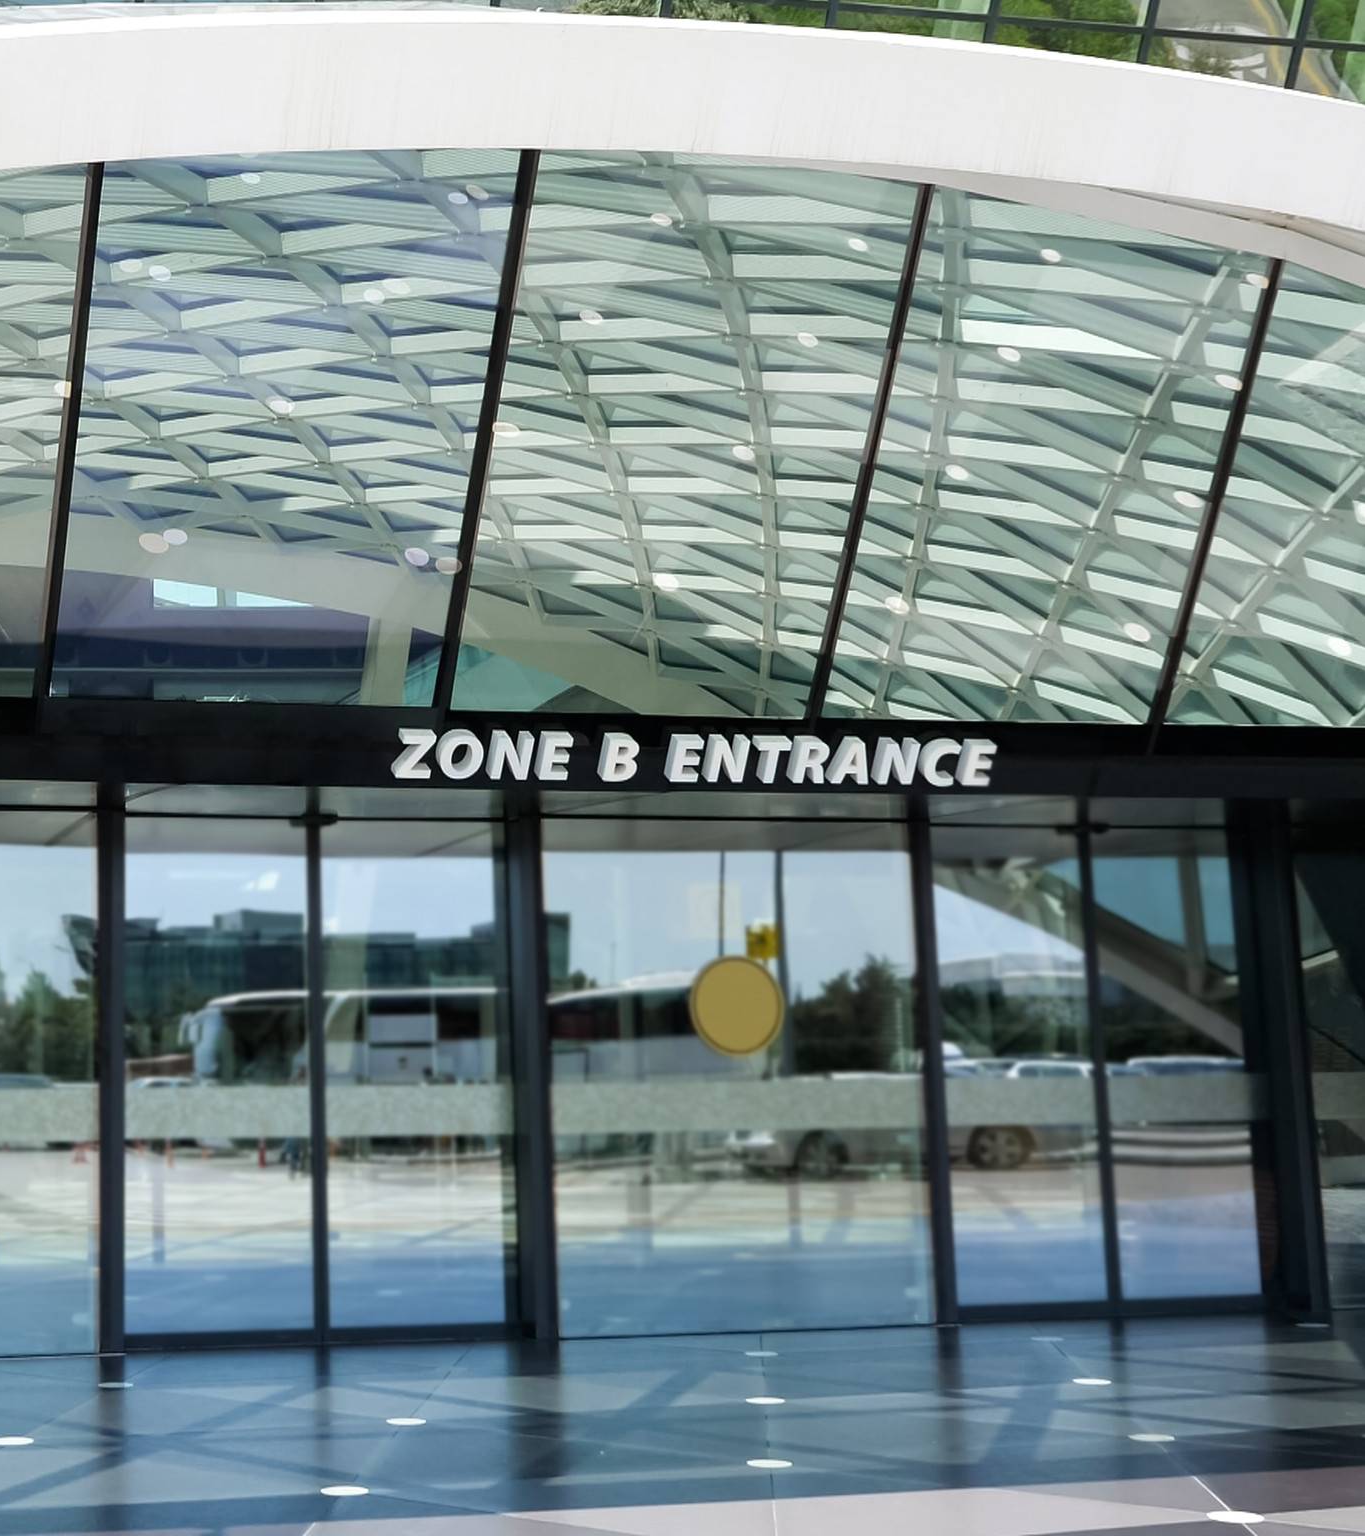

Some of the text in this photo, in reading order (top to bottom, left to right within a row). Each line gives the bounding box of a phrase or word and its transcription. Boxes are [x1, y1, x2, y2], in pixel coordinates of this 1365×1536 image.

[391, 727, 998, 787] ZONE B ENTRANCE
